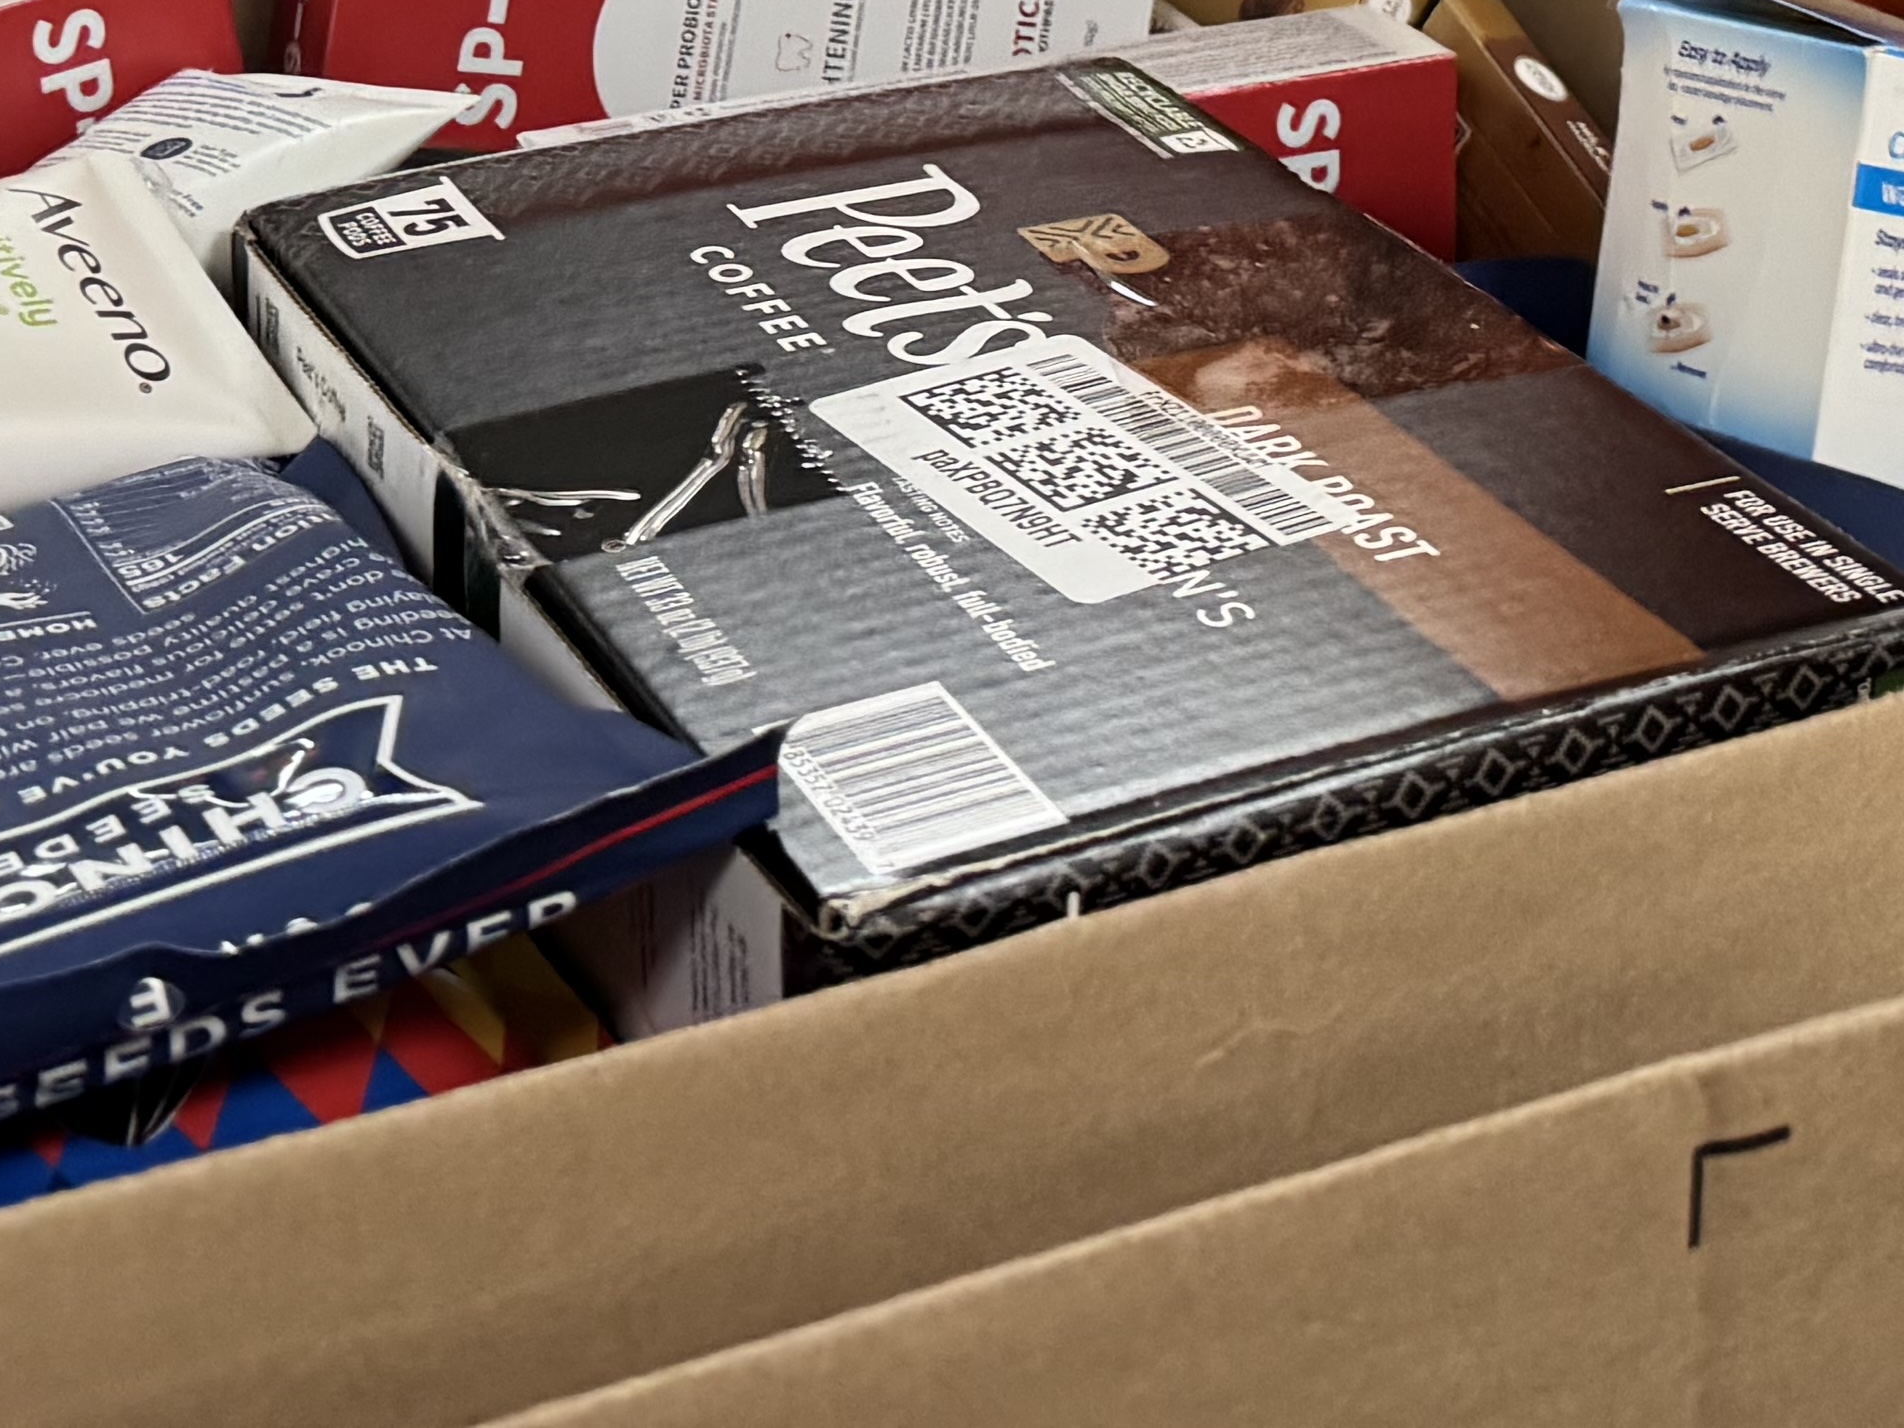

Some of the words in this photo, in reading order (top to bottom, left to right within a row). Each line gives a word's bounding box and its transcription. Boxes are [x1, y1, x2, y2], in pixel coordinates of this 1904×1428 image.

[32, 9, 117, 136] SP
[1678, 40, 1708, 64] Easy
[1731, 51, 1772, 78] Apply
[1276, 98, 1342, 194] SP
[336, 221, 375, 247] PODS
[355, 212, 397, 245] COFFEE
[386, 197, 472, 237] 75
[7, 186, 173, 384] Aveeno
[727, 164, 1054, 366] Peet's
[690, 244, 829, 352] COFFEE
[932, 510, 971, 544] NOTES
[1723, 489, 1777, 517] FOR
[1761, 514, 1817, 542] USE
[1798, 539, 1840, 557] IN
[116, 550, 186, 578] 165
[264, 537, 369, 593] highest
[284, 557, 361, 597] crave
[852, 481, 925, 546] Flavorful,
[904, 543, 972, 593] robust,
[952, 589, 1057, 672] full-bodied
[1699, 502, 1775, 545] SERVE
[1757, 541, 1863, 603] BREWERS
[142, 554, 244, 611] Facts
[310, 569, 384, 602] don't
[111, 612, 197, 647] seeds
[151, 599, 278, 667] delicious
[163, 594, 258, 648] quality
[229, 601, 305, 648] settle
[439, 626, 472, 642] At
[34, 671, 175, 707] mediocre
[172, 653, 290, 716] pastime
[351, 656, 439, 681] THE
[47, 719, 110, 743] pair
[151, 671, 295, 738] sunflower
[203, 676, 339, 748] SEEDS
[47, 731, 139, 764] seeds
[17, 746, 190, 805] YOU'VE
